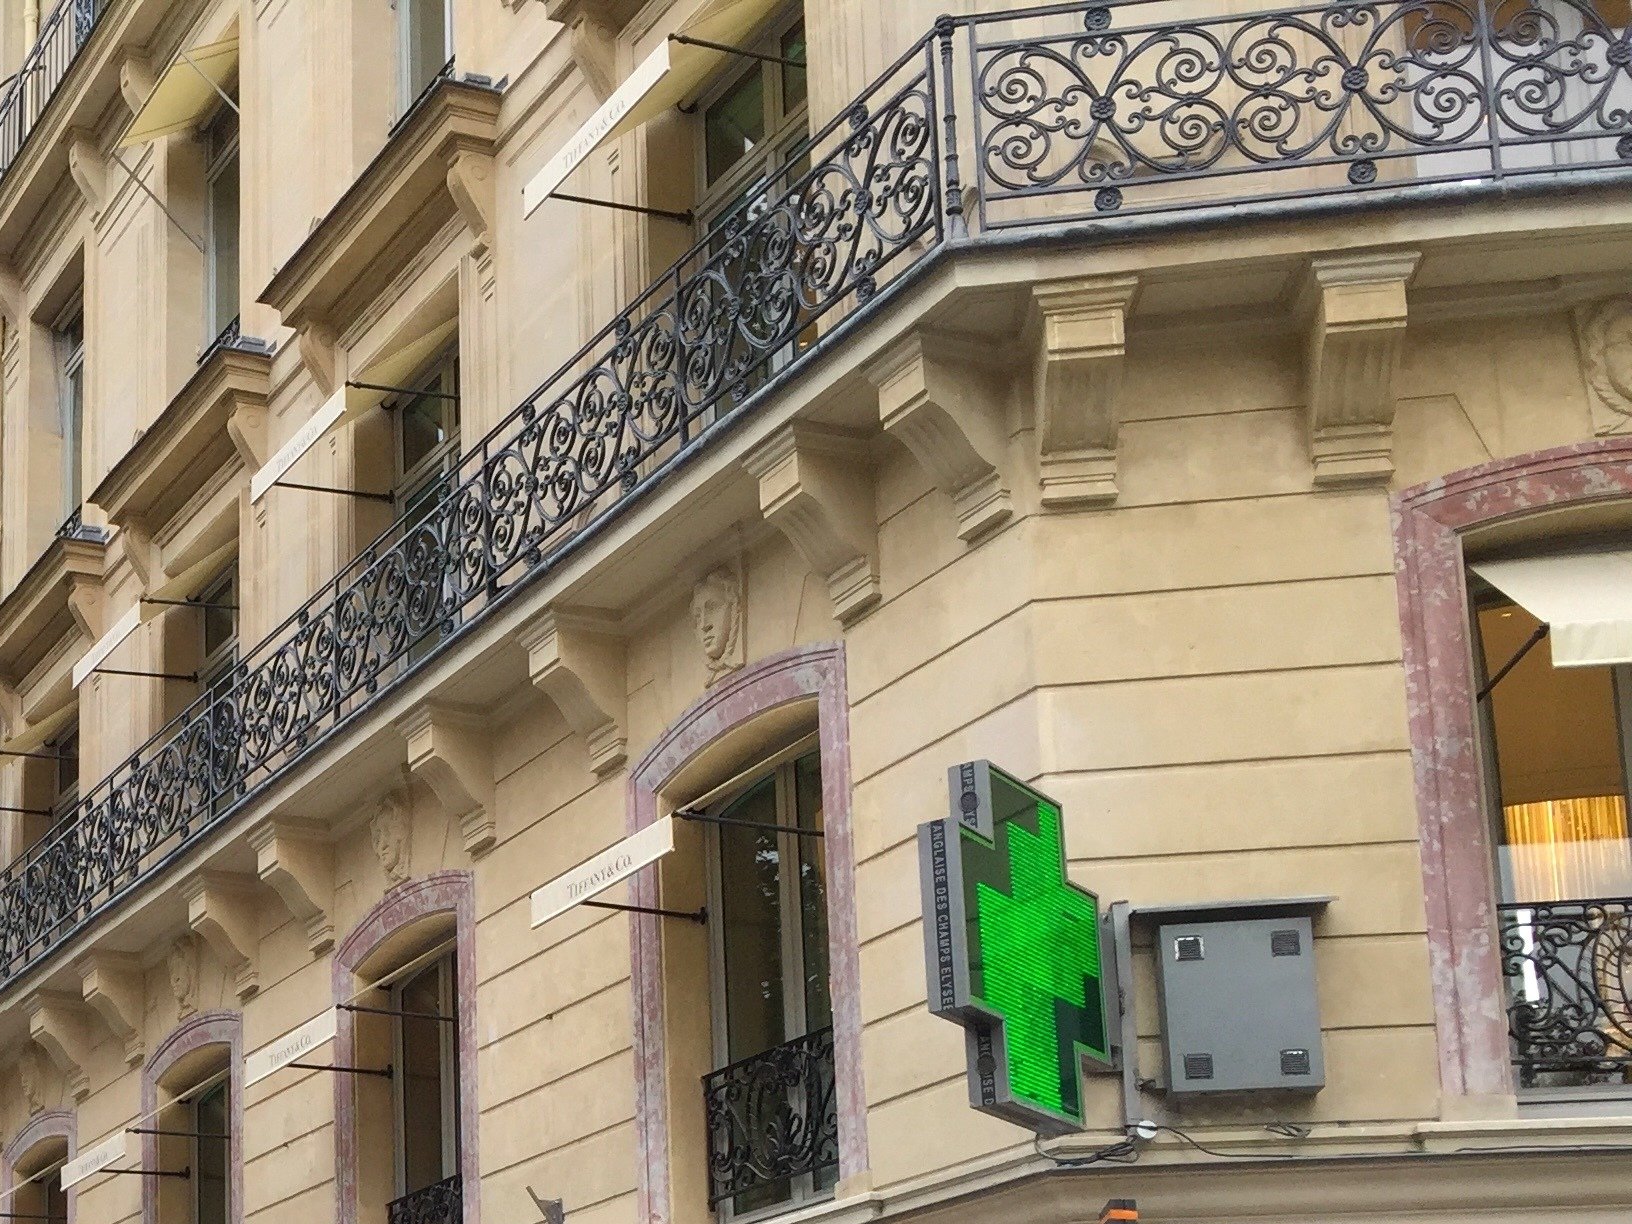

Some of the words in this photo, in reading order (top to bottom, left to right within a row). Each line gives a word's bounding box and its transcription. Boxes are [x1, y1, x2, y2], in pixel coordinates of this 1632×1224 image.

[932, 826, 946, 882] ANGLAISE
[936, 888, 948, 910] DES
[938, 914, 951, 963] CHAMPS
